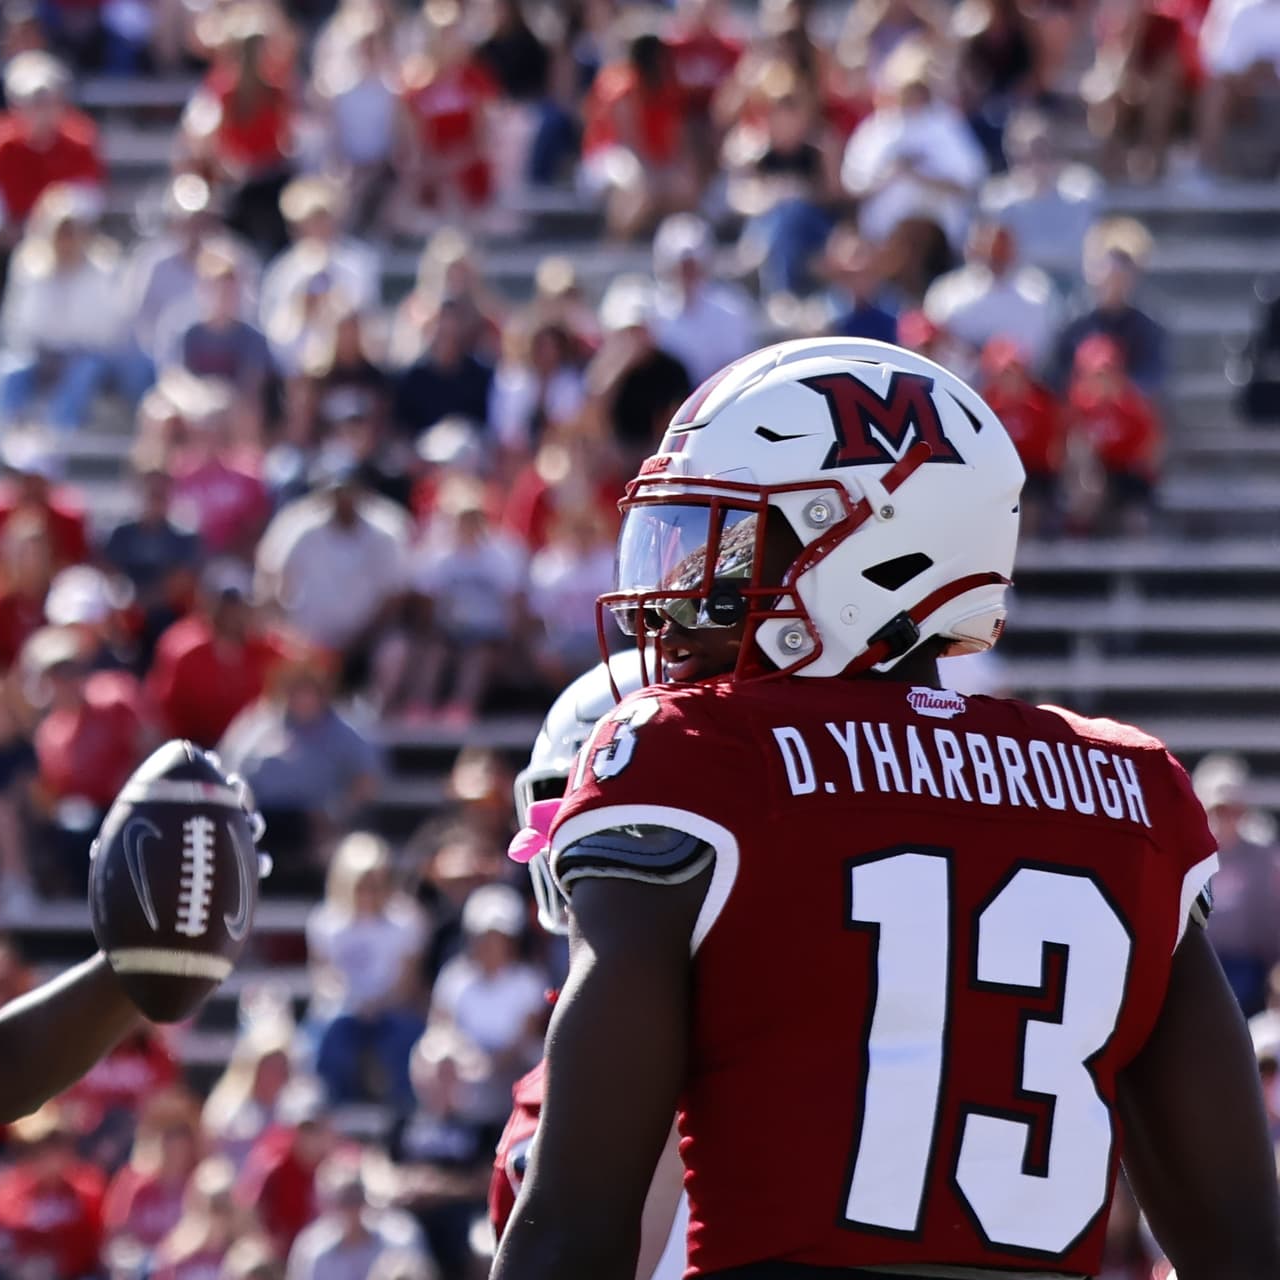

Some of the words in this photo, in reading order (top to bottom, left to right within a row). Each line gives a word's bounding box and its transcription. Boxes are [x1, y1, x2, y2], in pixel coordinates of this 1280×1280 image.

[796, 371, 966, 471] M
[570, 696, 662, 794] 13
[908, 692, 966, 712] Miami
[771, 721, 1153, 828] D.YHARBROUGH
[837, 846, 1135, 1261] 13
